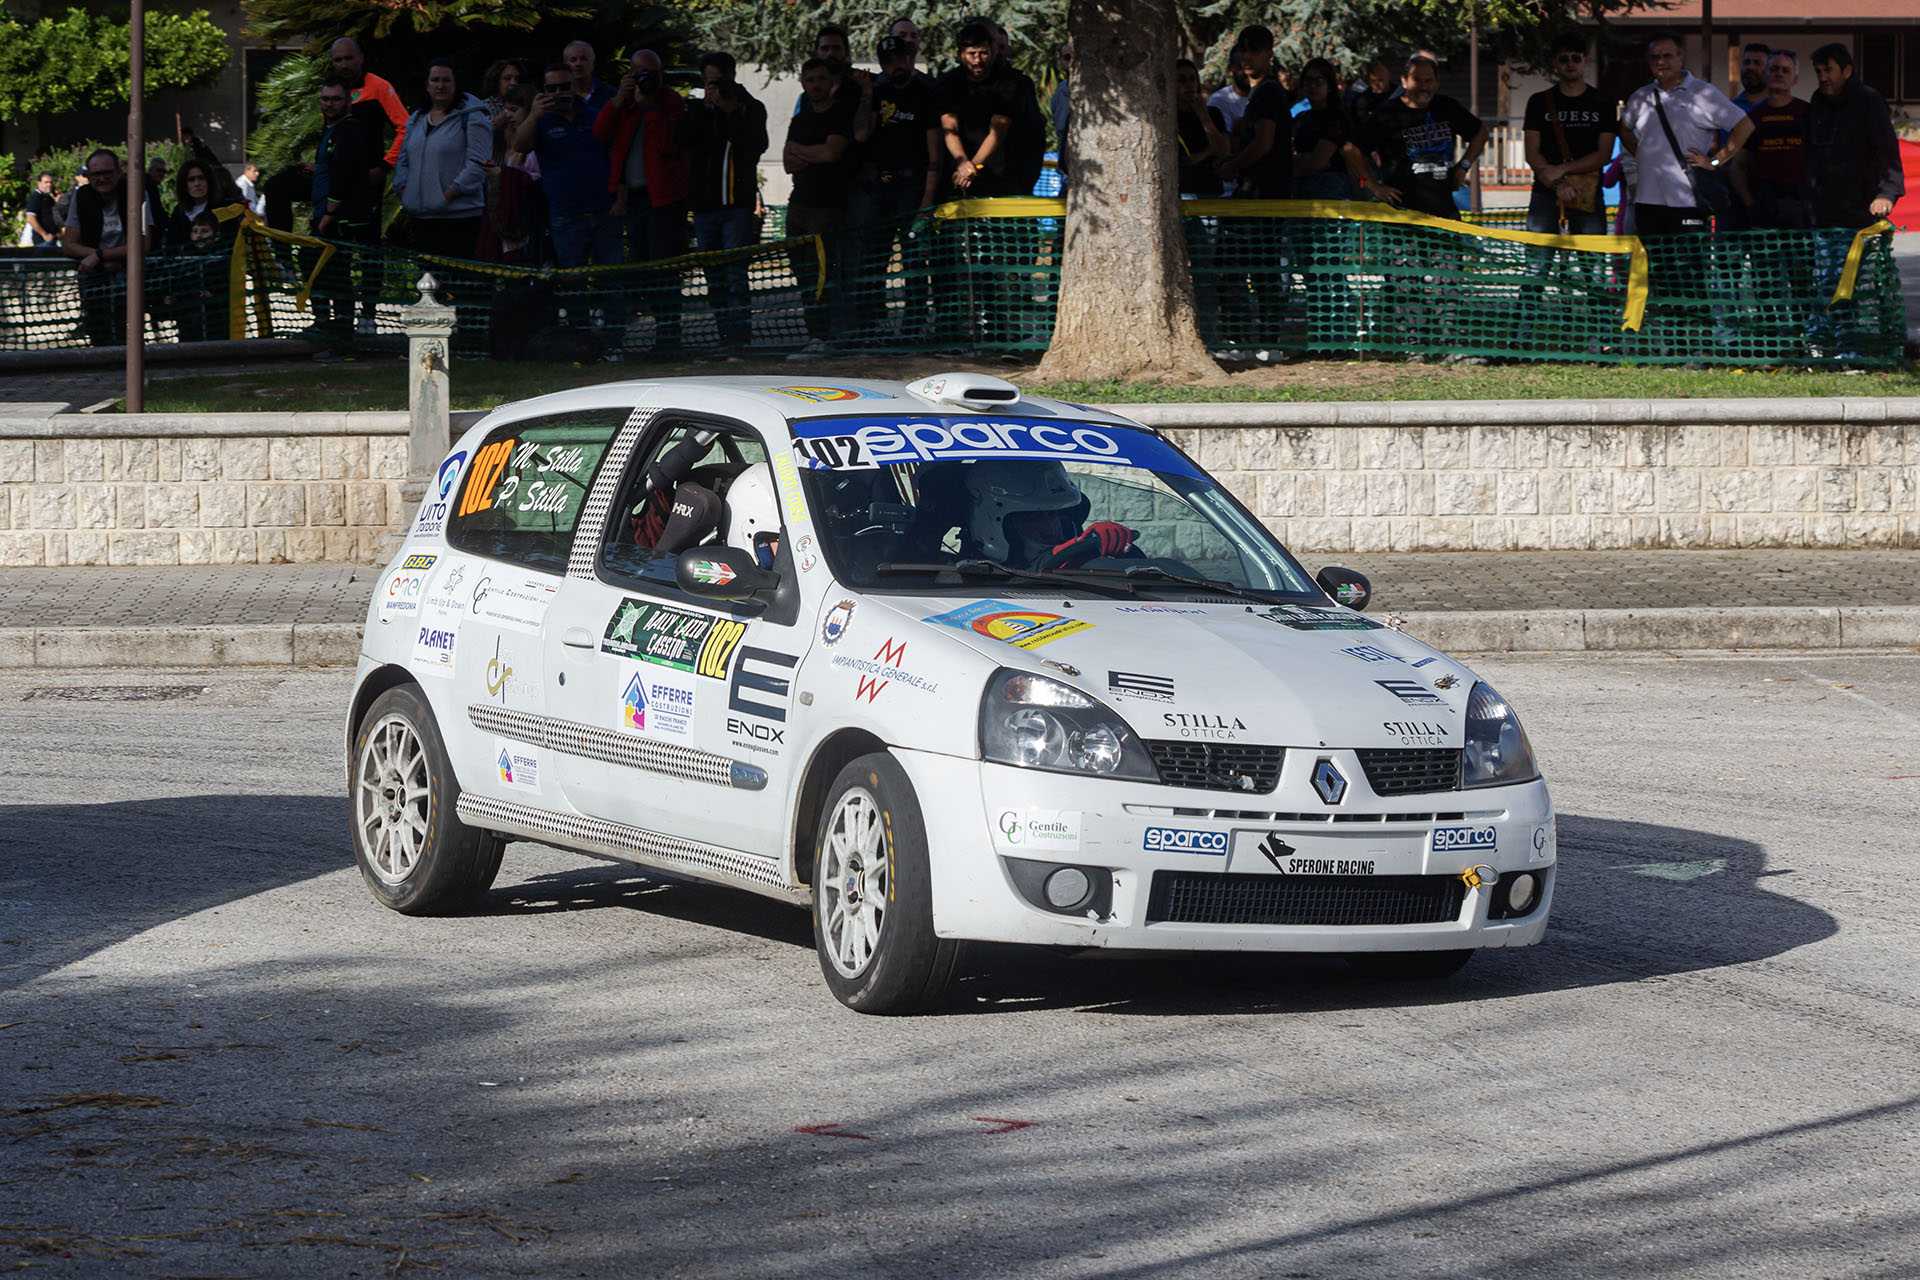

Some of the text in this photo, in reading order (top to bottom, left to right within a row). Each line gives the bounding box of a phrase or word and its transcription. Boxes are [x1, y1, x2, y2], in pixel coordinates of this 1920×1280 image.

[792, 436, 871, 468] 102
[857, 422, 1119, 461] sparco
[512, 441, 584, 473] M. Stilla
[458, 438, 515, 517] 102
[494, 475, 570, 513] P. Stilla
[671, 502, 695, 518] HRX
[389, 574, 427, 597] enel
[643, 610, 681, 635] RALLY
[418, 627, 455, 651] PLANET
[647, 633, 688, 661] CASSINO
[698, 620, 746, 680] 102
[832, 654, 881, 675] IMPIANTISTICA
[880, 666, 923, 689] GENERALE
[652, 684, 693, 705] EFFERRE
[1109, 687, 1174, 701] ENOX
[651, 700, 692, 715] COSTRUZIONI
[727, 718, 785, 745] ENOX
[1163, 712, 1247, 731] STILLA
[1383, 721, 1449, 737] STILLA
[1180, 728, 1237, 740] OTTICA
[1401, 735, 1444, 746] OTTICA
[514, 755, 537, 769] EFFERRE
[1029, 820, 1069, 834] Gentile
[1031, 830, 1078, 842] Costruzioni
[1146, 829, 1225, 851] sparco
[1435, 827, 1496, 851] sparco
[1289, 858, 1376, 875] SPERONE RACING
